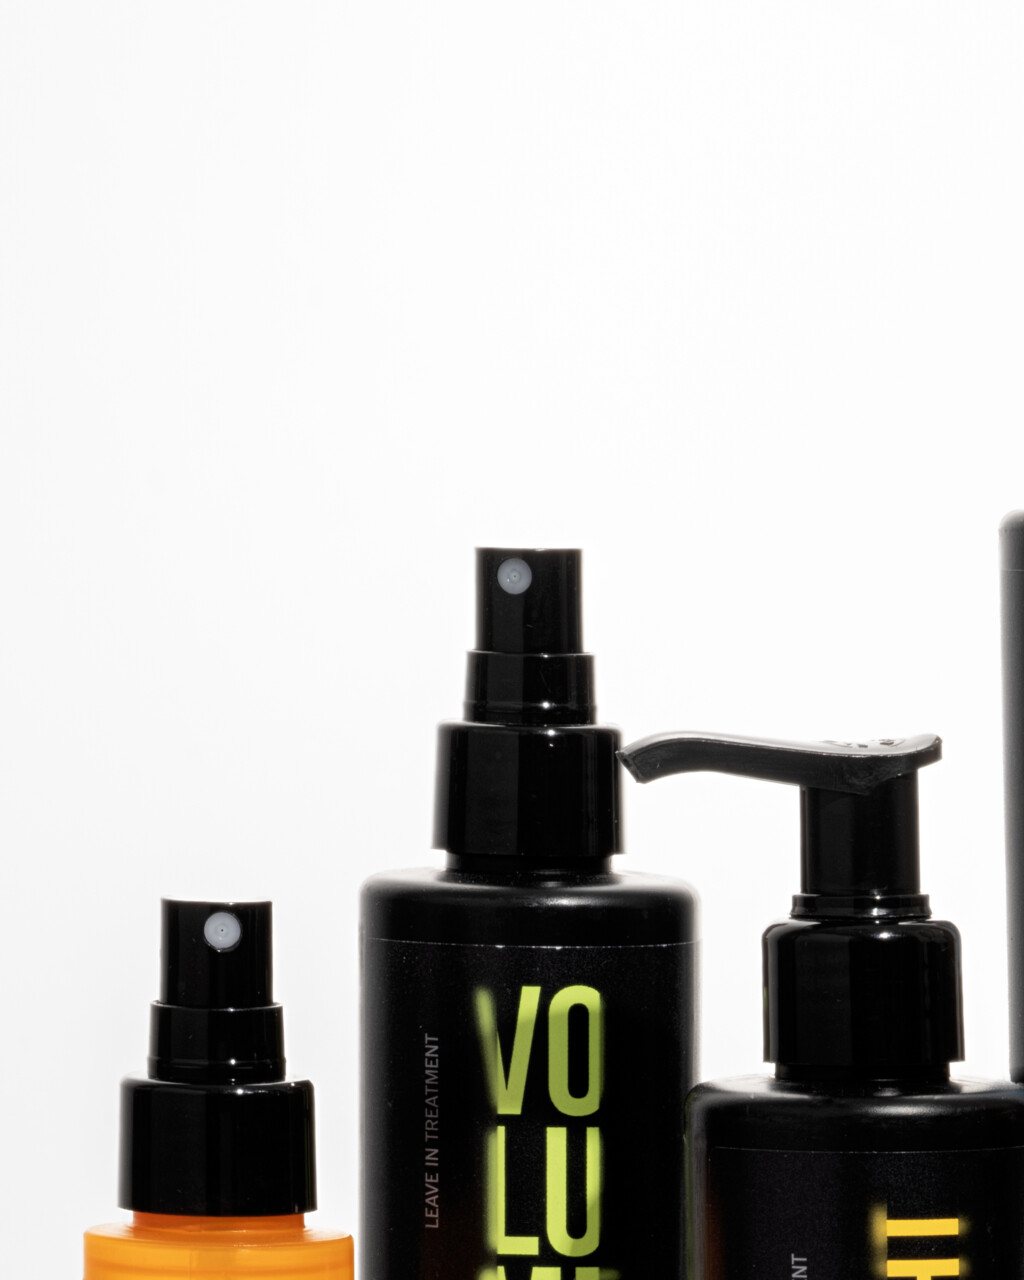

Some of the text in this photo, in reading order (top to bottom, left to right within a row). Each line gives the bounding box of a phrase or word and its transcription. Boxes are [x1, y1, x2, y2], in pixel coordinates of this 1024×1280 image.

[473, 985, 604, 1116] VO
[425, 1034, 439, 1229] LEAVE IN TREATMENT
[486, 1126, 602, 1257] LU
